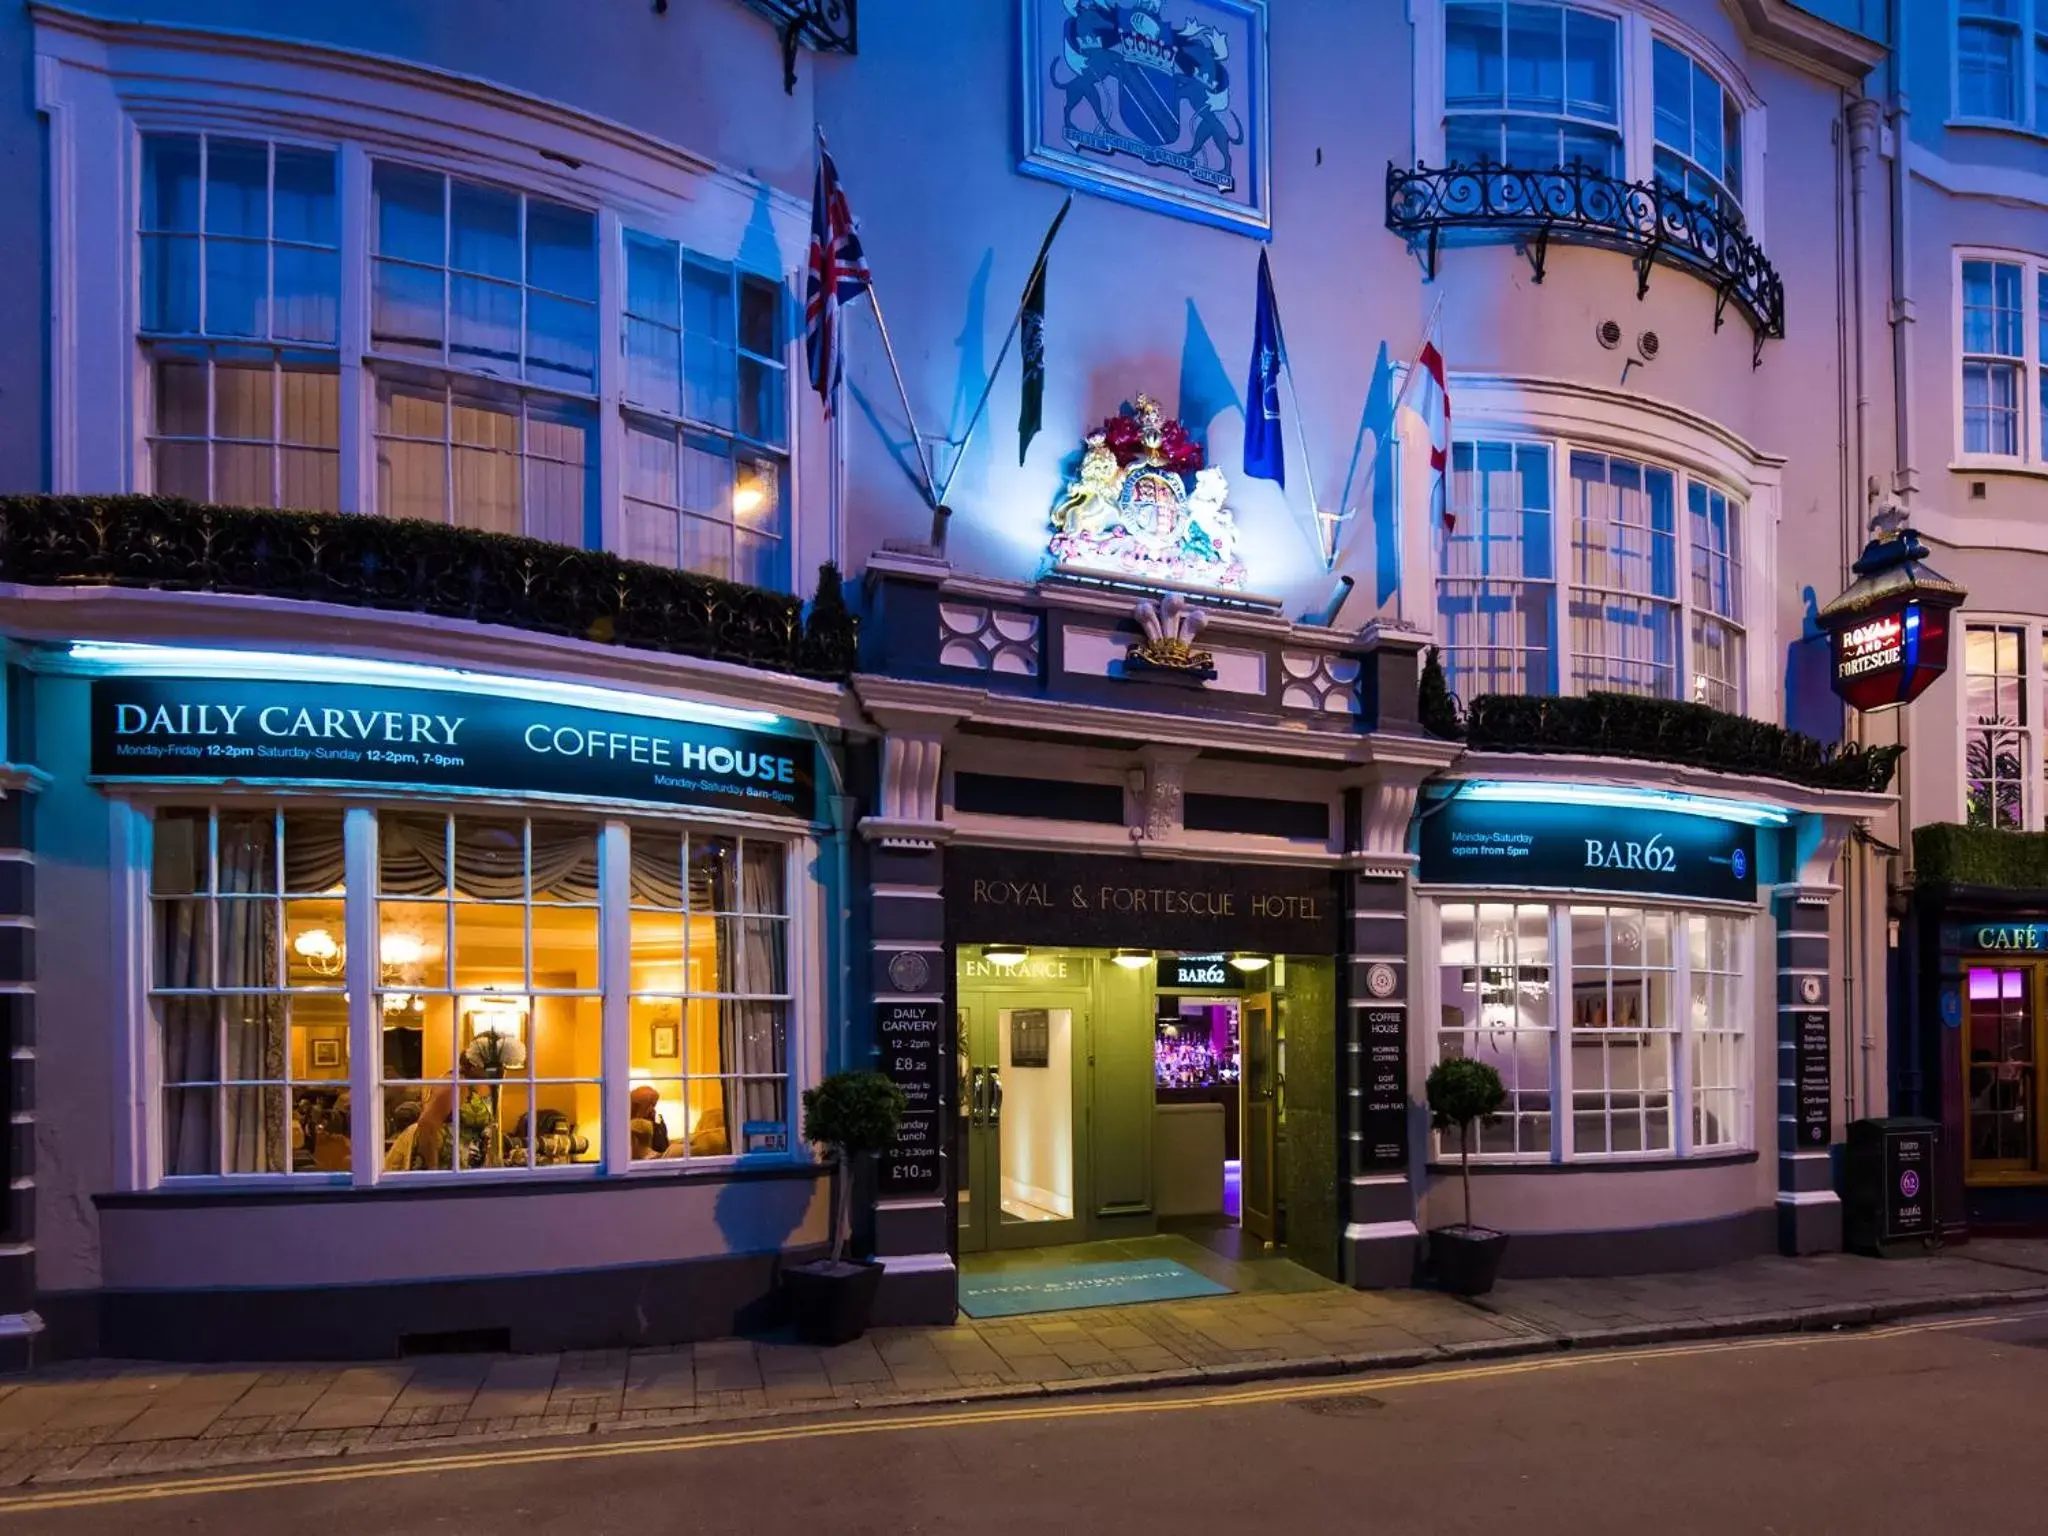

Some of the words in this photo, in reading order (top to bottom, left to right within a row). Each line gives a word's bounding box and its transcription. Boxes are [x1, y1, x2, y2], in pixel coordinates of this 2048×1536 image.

[1843, 618, 1895, 648] ROYAL
[1855, 639, 1882, 656] AND
[1838, 647, 1900, 678] FORTESCUE
[115, 704, 246, 735] DAILY
[259, 706, 466, 746] CARVERY
[117, 743, 203, 758] Monday-Friday
[206, 744, 254, 757] 12-2pm
[257, 744, 363, 763] Saturday-Sunday
[366, 749, 419, 766] 12-2pm,
[422, 752, 465, 767] 7-9pm
[524, 723, 672, 767] COFFEE
[682, 742, 795, 784] HOUSE
[654, 773, 745, 797] Monday-Saturday
[1452, 831, 1534, 844] Monday-Saturday
[1452, 848, 1479, 857] open
[1481, 846, 1504, 855] from
[1507, 846, 1529, 857] 5pm
[1584, 833, 1677, 873] BAR62
[973, 880, 1055, 908] ROYAL
[1071, 885, 1088, 909] &
[1101, 887, 1236, 917] FORTESCUE
[1252, 896, 1323, 919] HOTEL
[1978, 924, 2040, 949] CAFÉ
[966, 961, 1068, 979] ENTRANCE
[1177, 964, 1226, 983] BAR62
[893, 1008, 927, 1019] DAILY
[1369, 1012, 1401, 1021] COFFEE
[882, 1020, 937, 1032] CARVERY
[1371, 1023, 1399, 1033] HOUSE
[909, 1040, 930, 1050] 2pm
[896, 1132, 926, 1142] Lunch
